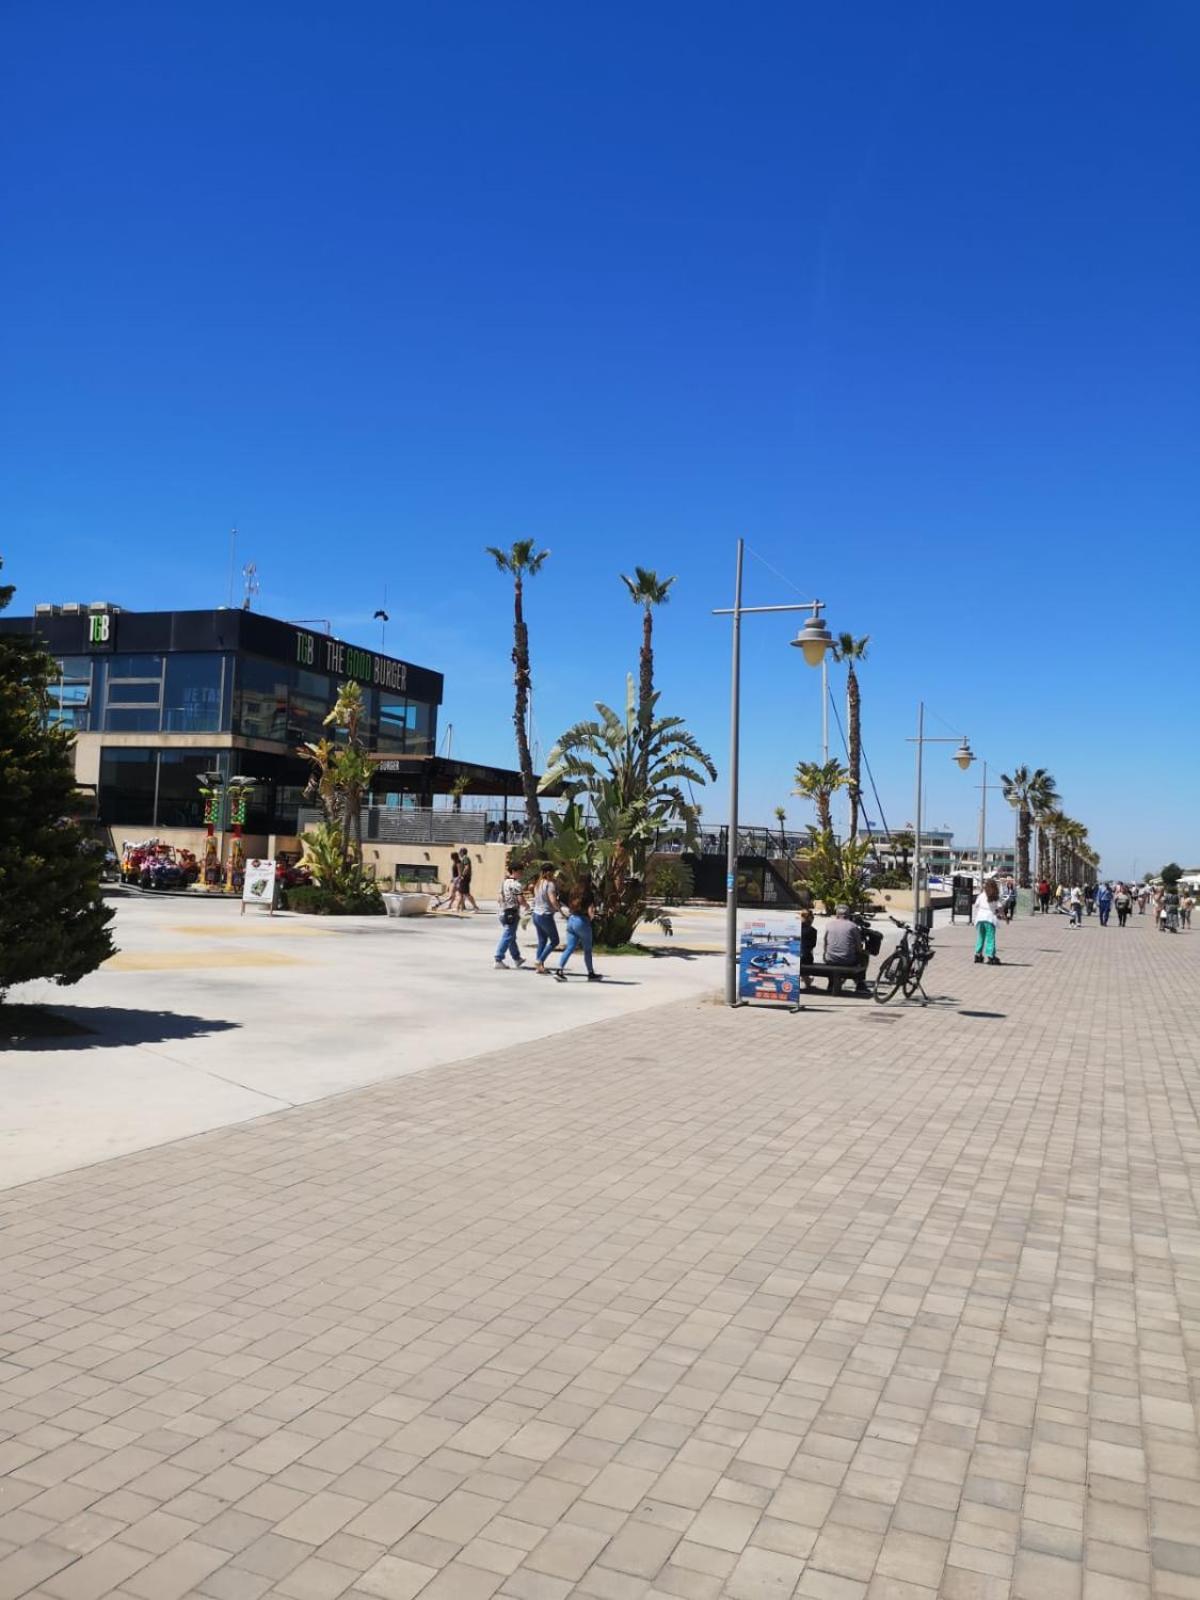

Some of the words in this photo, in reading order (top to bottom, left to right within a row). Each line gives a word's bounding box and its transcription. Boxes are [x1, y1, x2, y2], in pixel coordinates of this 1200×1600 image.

[89, 614, 110, 642] TGB
[296, 632, 314, 665] TGB
[326, 641, 344, 673] THE
[346, 647, 371, 681] GOOD
[373, 656, 407, 692] BURGER
